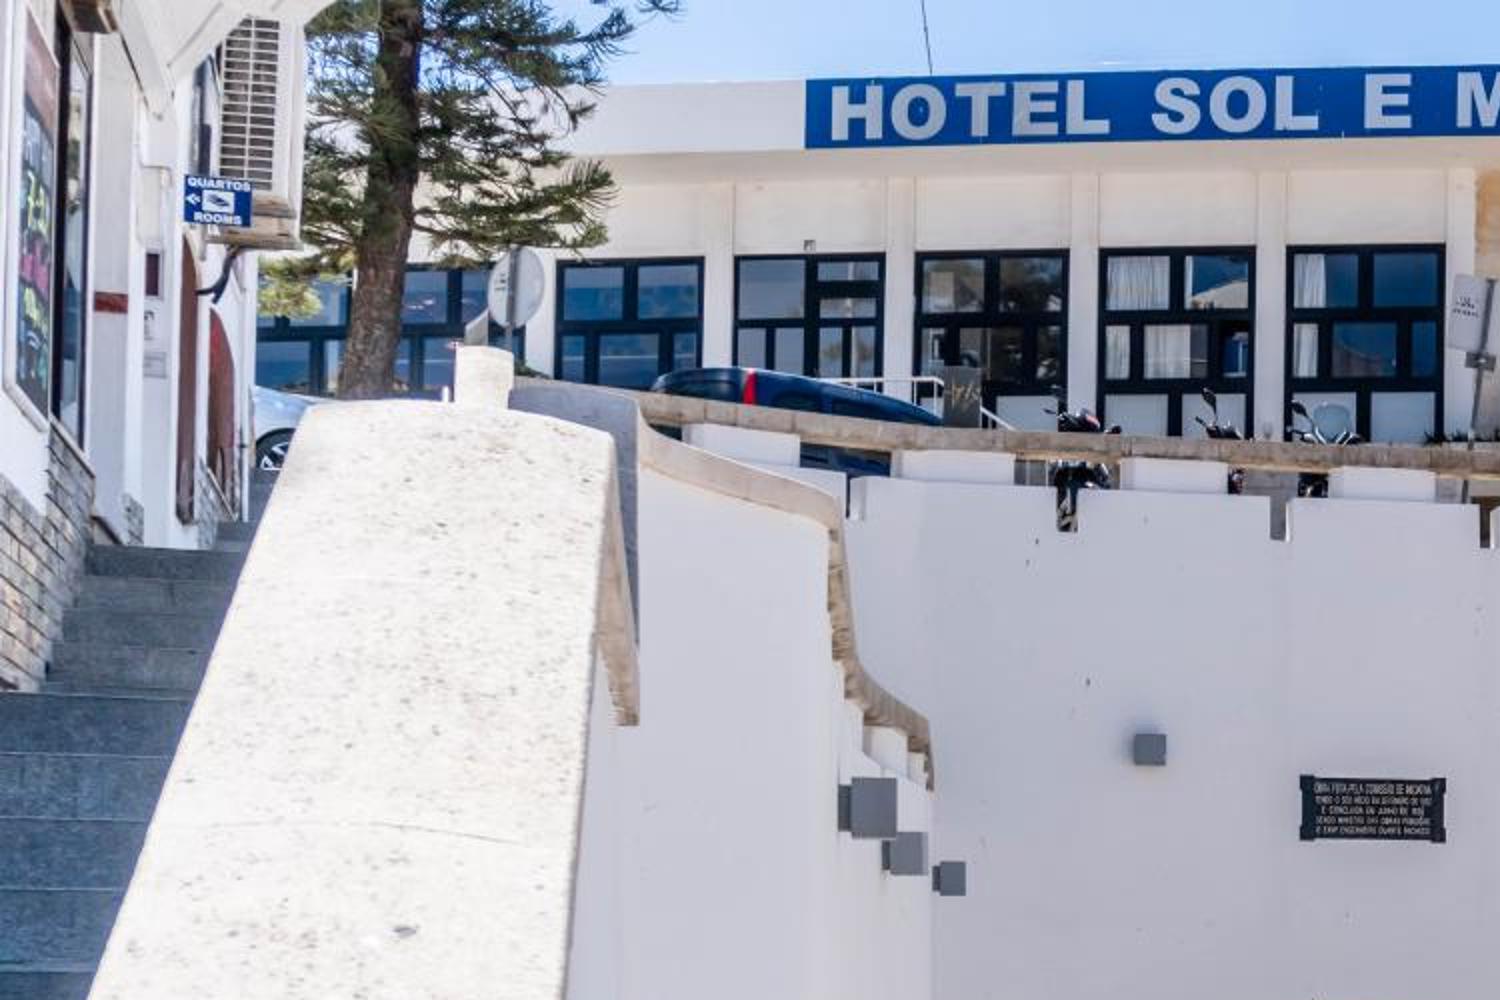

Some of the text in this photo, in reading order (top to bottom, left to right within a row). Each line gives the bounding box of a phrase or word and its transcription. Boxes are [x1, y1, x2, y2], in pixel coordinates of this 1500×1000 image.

[831, 79, 1111, 141] HOTEL
[1151, 75, 1320, 134] SOL
[1364, 73, 1412, 129] E
[187, 177, 251, 192] QUARTOS
[193, 211, 242, 225] ROOMS
